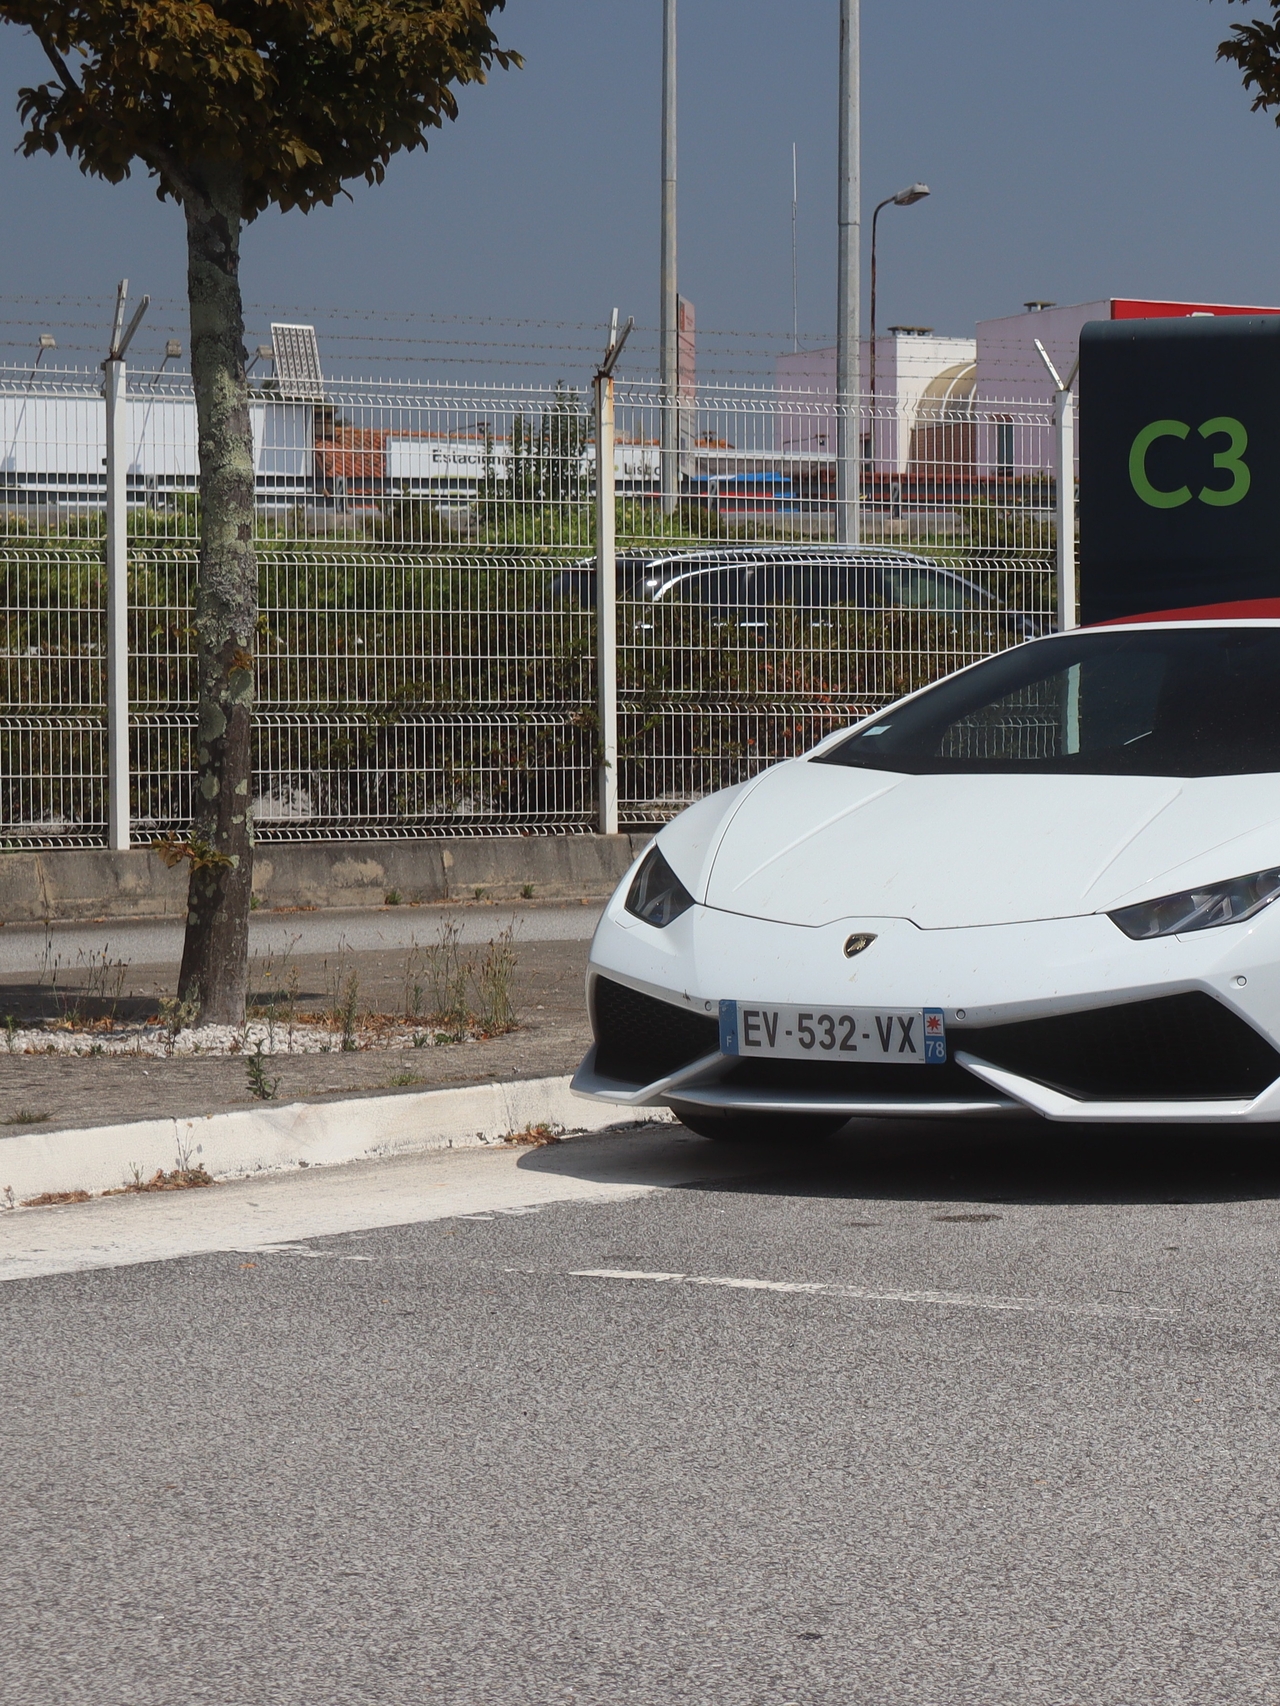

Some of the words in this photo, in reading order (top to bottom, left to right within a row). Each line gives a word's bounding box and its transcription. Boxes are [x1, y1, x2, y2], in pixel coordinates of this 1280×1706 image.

[1129, 416, 1251, 509] C3
[726, 1036, 732, 1048] F
[743, 1009, 917, 1054] EV-532-VX
[925, 1041, 945, 1058] 78
